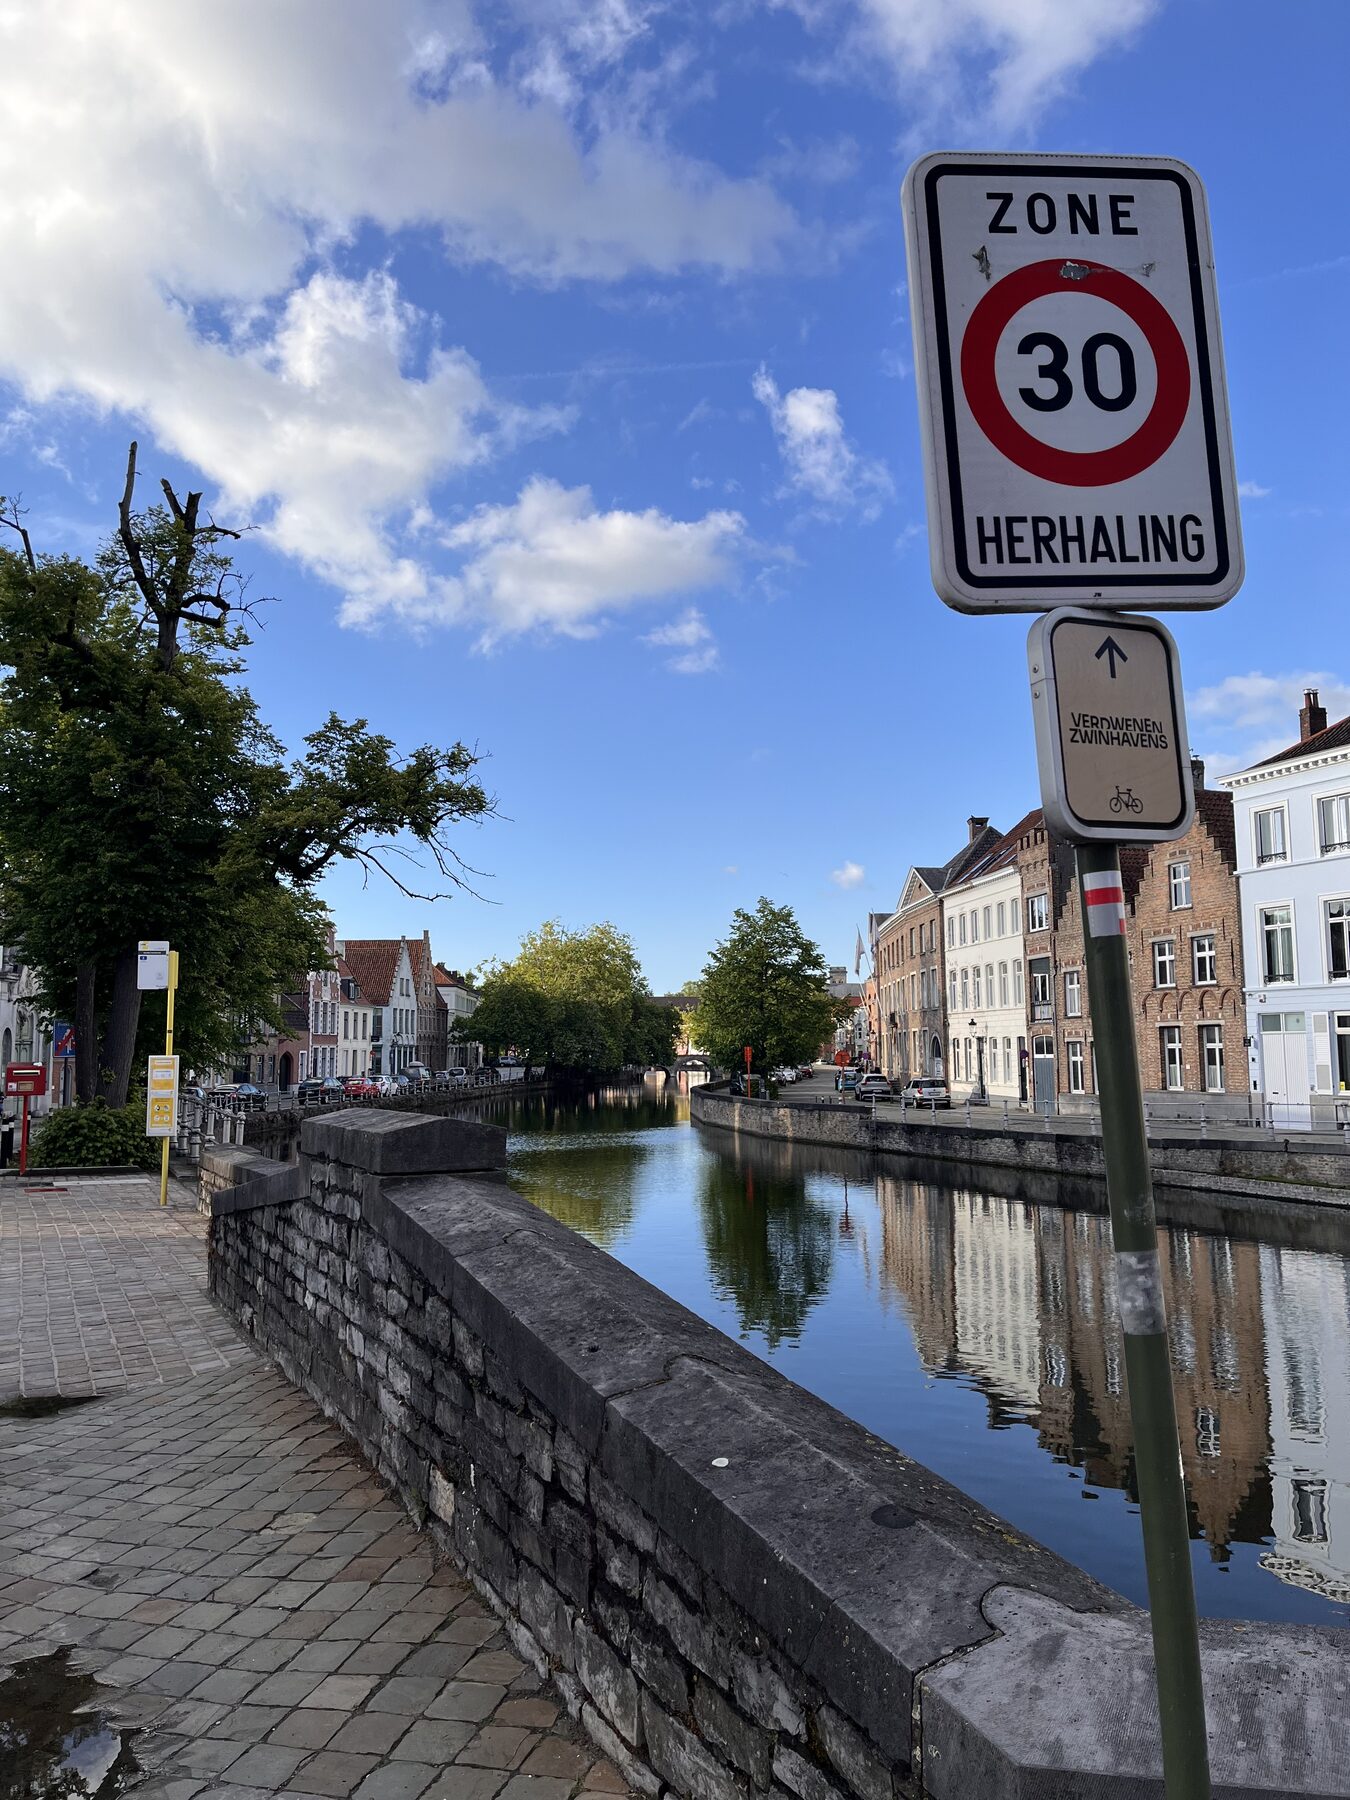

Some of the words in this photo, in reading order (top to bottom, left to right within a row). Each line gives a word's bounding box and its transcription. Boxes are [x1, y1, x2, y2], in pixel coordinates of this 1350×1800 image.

[986, 192, 1139, 236] ZONE
[1017, 331, 1137, 413] 30
[976, 514, 1205, 564] HERHALING
[1070, 711, 1163, 733] VERDWENEN
[1070, 729, 1168, 749] ZWINHAVENS
